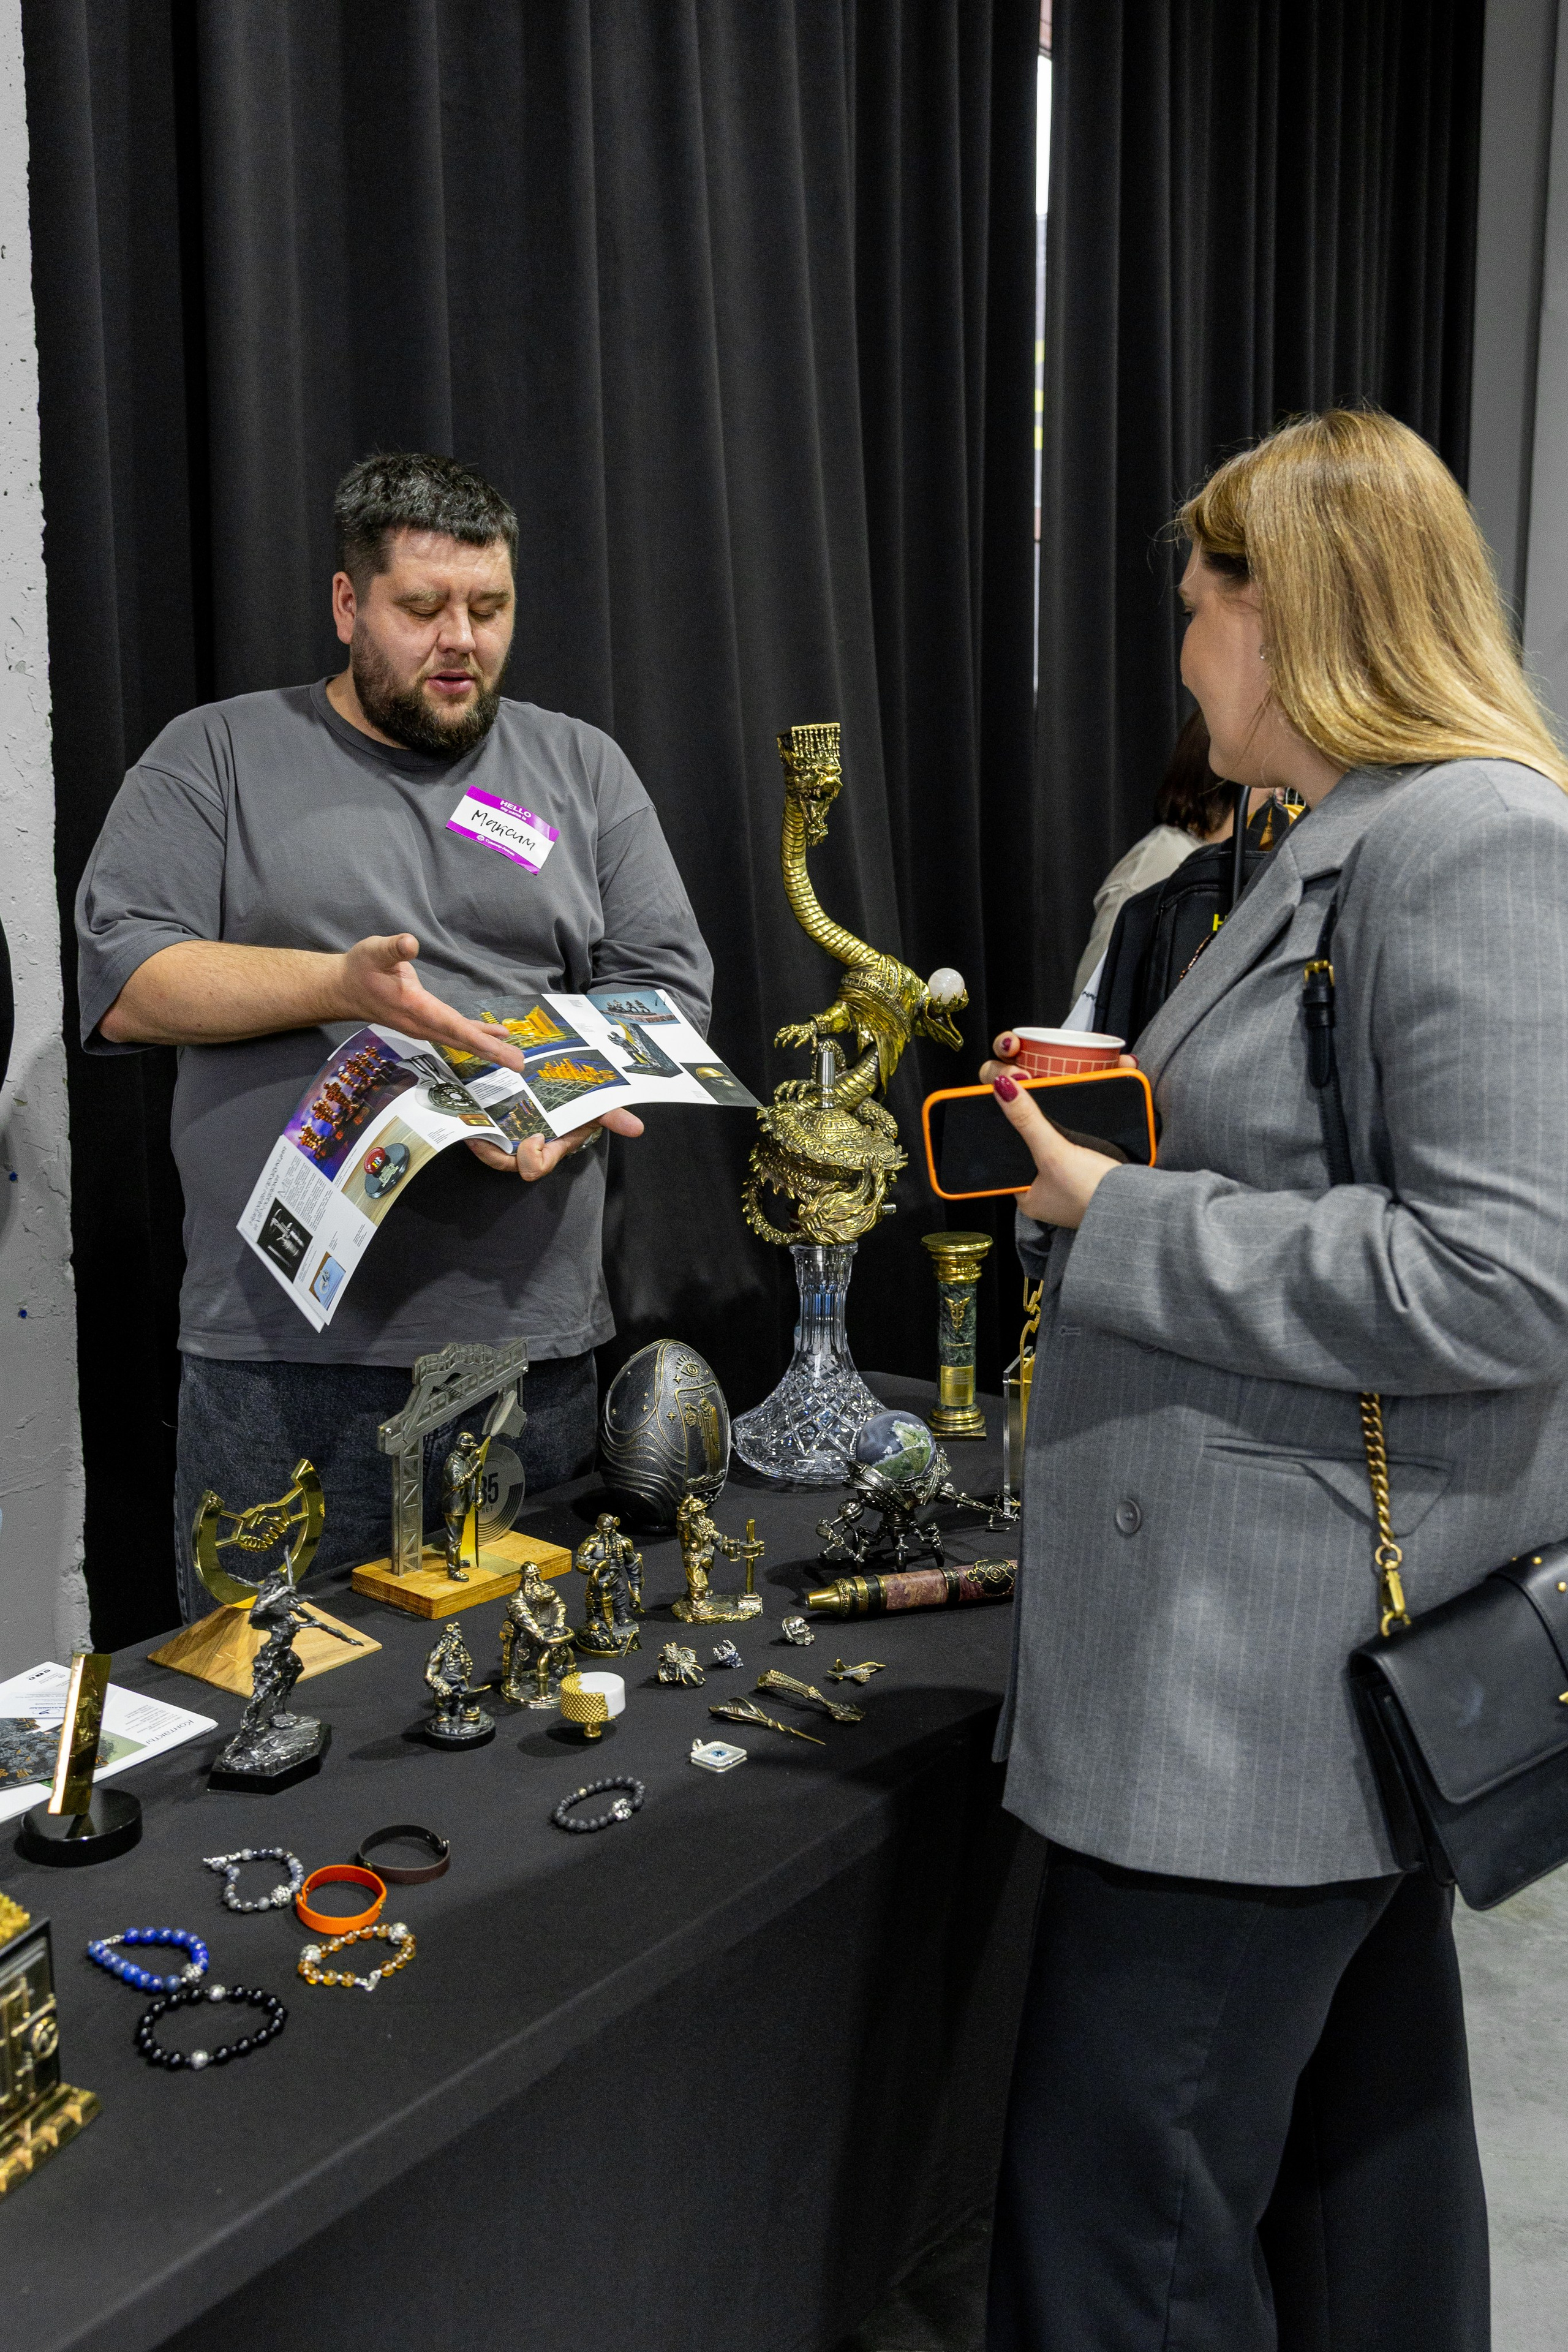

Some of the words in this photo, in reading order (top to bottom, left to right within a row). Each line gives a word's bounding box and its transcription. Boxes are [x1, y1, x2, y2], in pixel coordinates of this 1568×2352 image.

[500, 800, 532, 818] HELLO
[471, 810, 536, 851] Максим
[146, 1719, 194, 1744] Контакты
